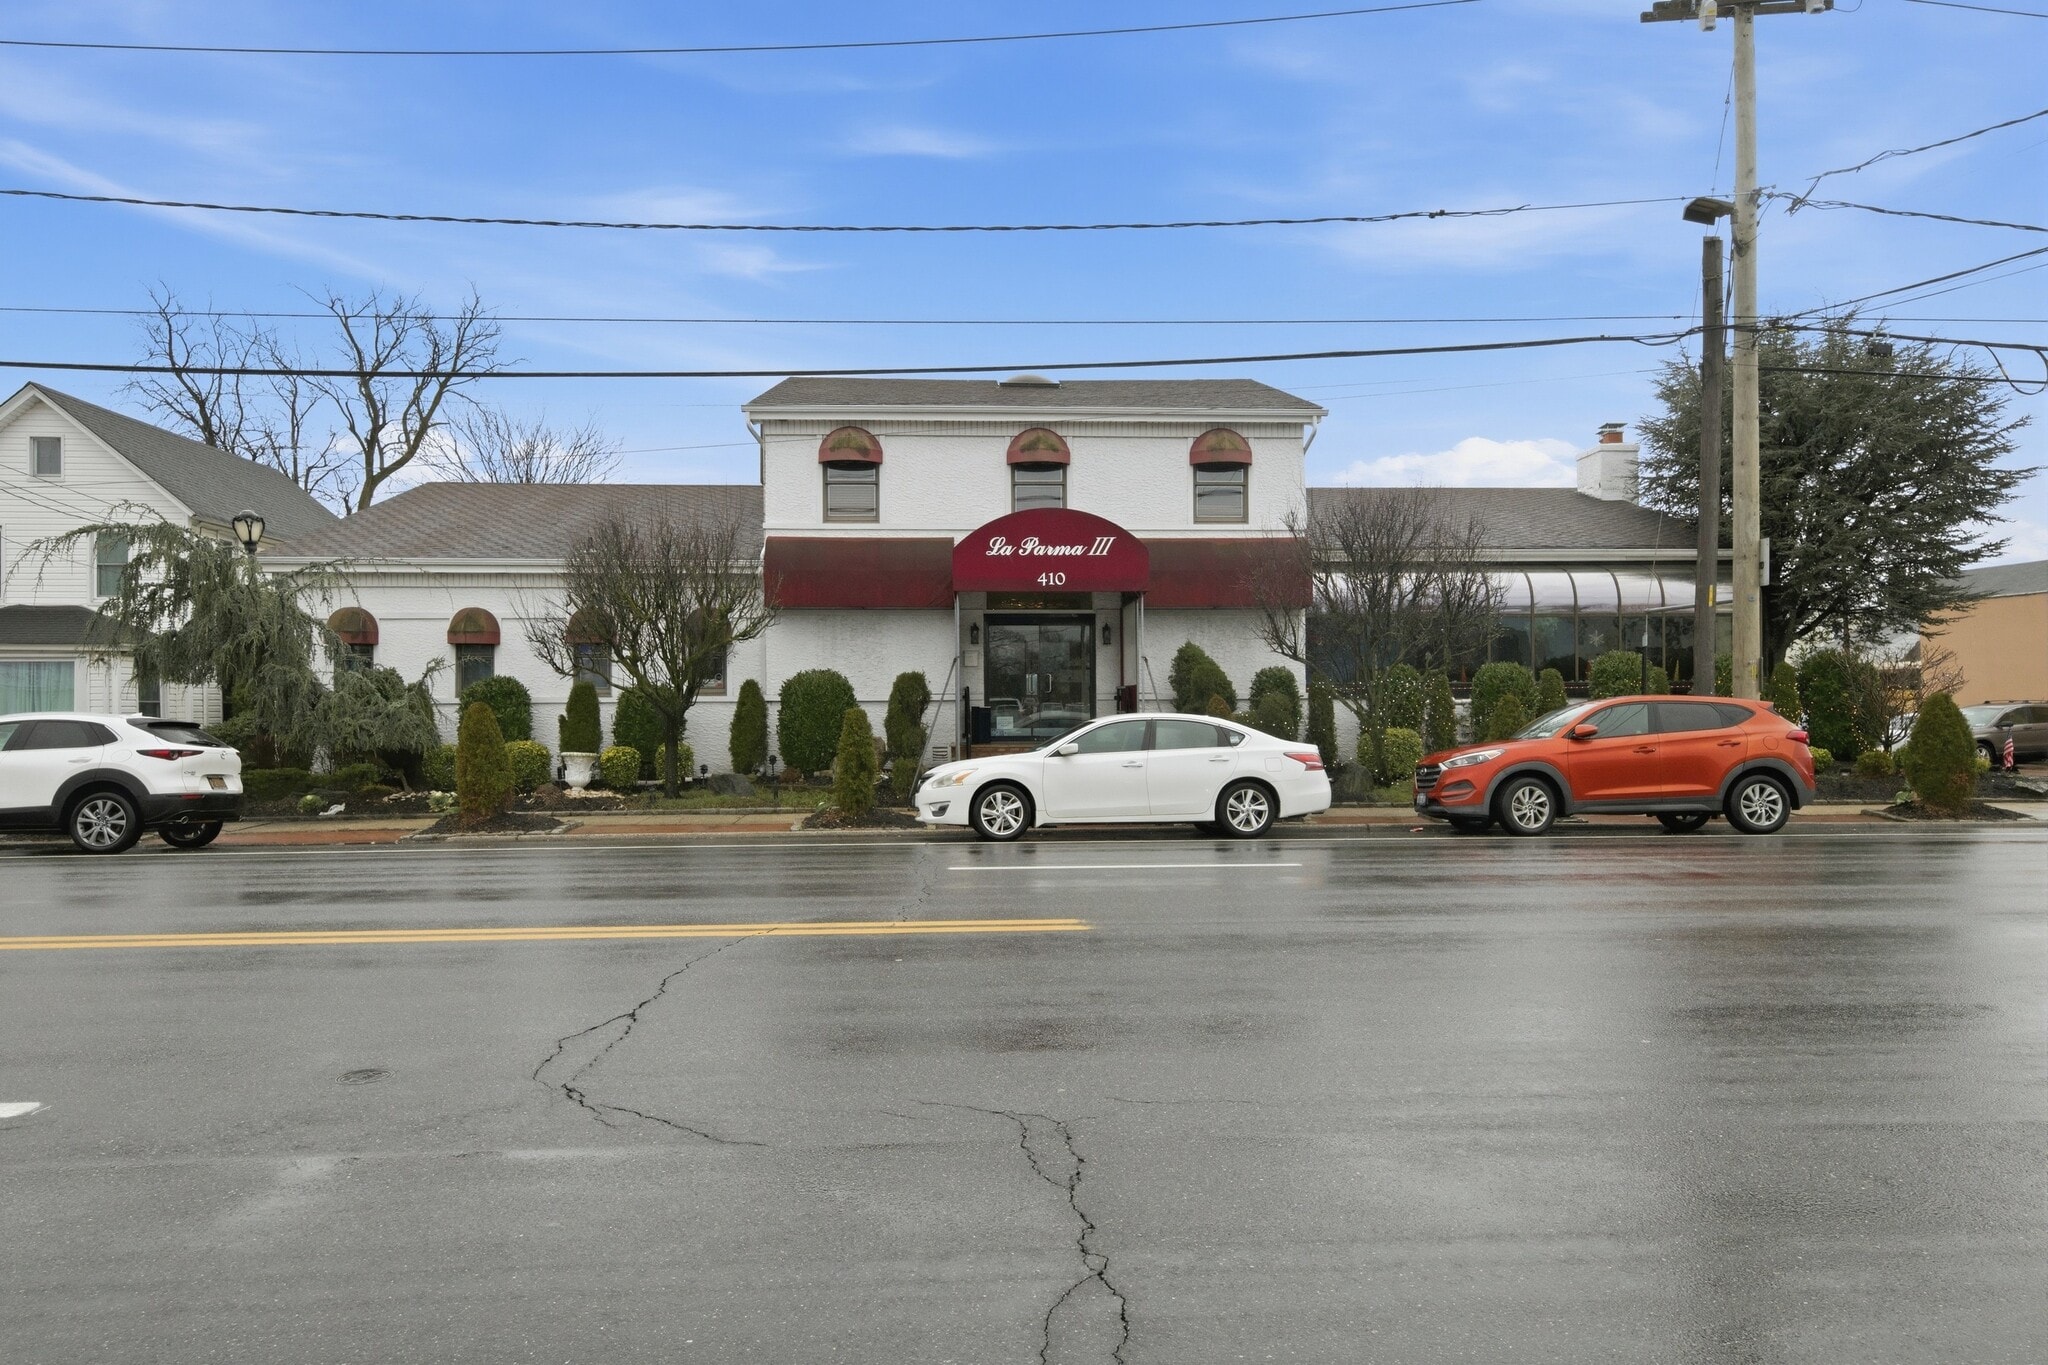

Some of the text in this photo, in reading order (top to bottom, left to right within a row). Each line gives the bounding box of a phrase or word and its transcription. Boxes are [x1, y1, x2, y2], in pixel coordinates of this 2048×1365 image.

[986, 536, 1117, 556] La Parma III
[1037, 572, 1066, 587] 410
